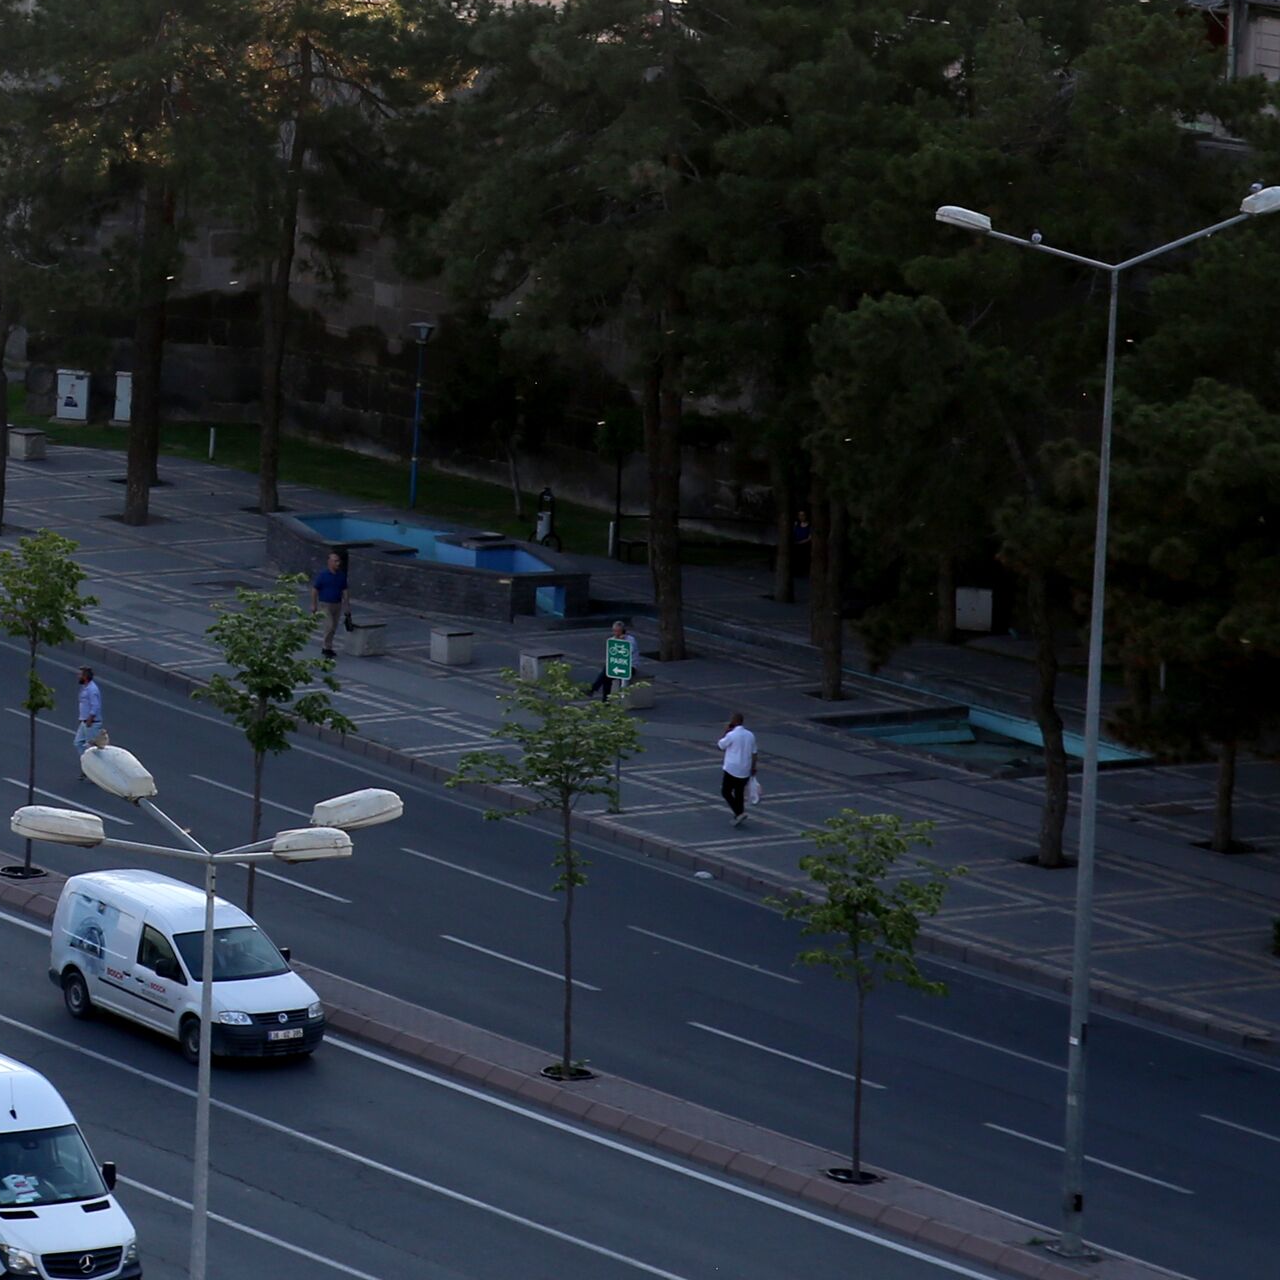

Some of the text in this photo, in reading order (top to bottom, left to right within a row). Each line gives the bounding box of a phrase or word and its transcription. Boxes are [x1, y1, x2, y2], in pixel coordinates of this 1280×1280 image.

[610, 656, 629, 666] PARK
[106, 967, 124, 981] BOSCH
[150, 982, 167, 994] BOSCH
